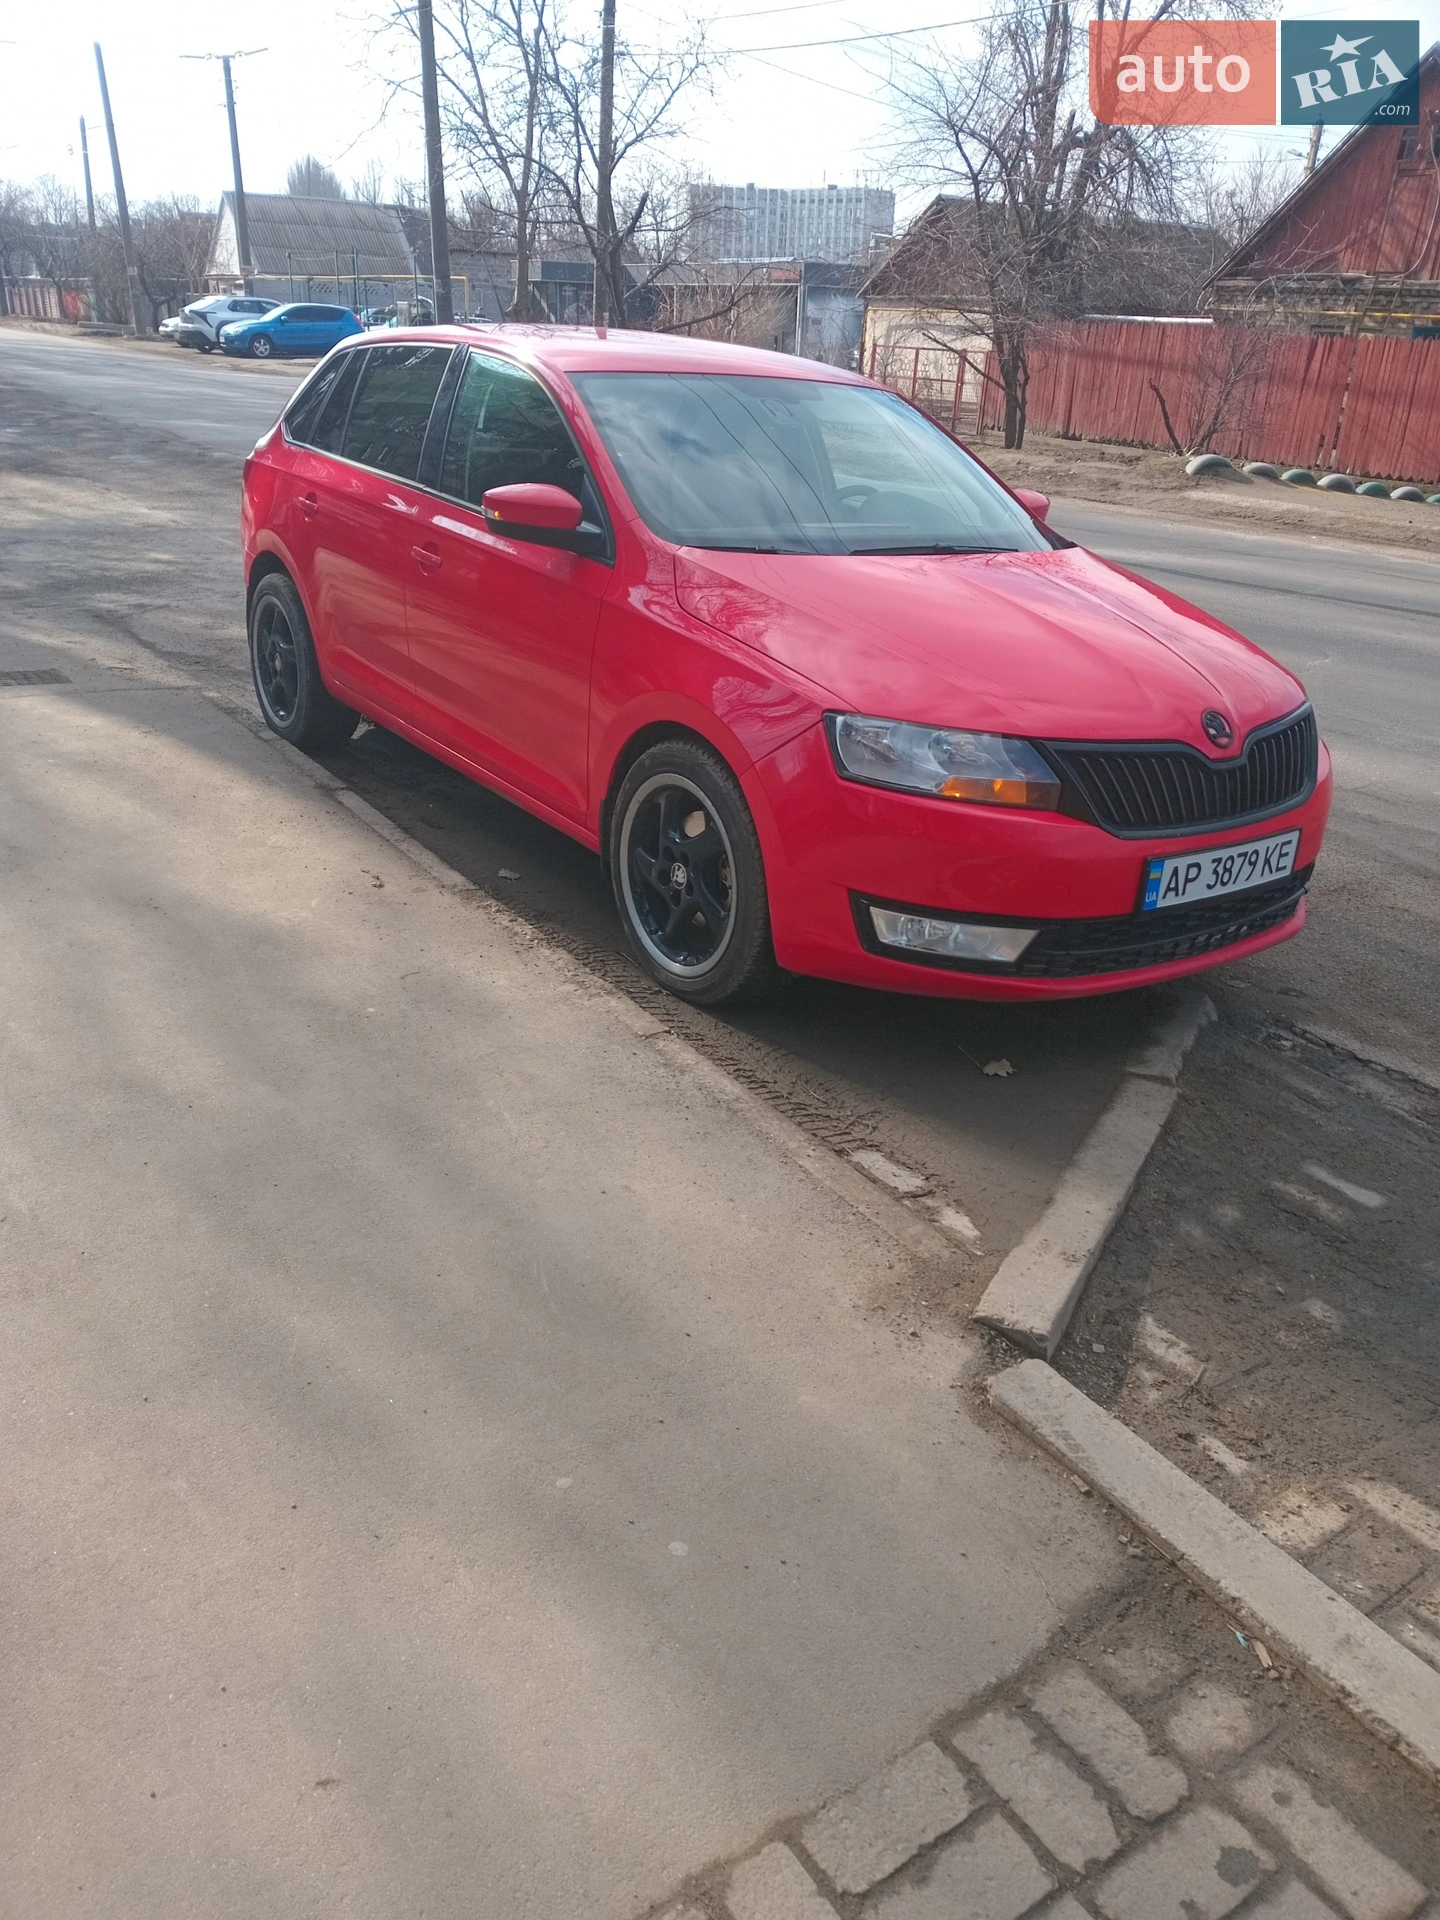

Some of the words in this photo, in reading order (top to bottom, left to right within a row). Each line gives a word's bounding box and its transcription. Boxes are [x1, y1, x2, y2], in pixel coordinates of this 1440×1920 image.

[1162, 862, 1202, 899] AP
[1206, 849, 1260, 890] 3879
[1261, 839, 1293, 877] KE
[1145, 893, 1157, 902] UA
